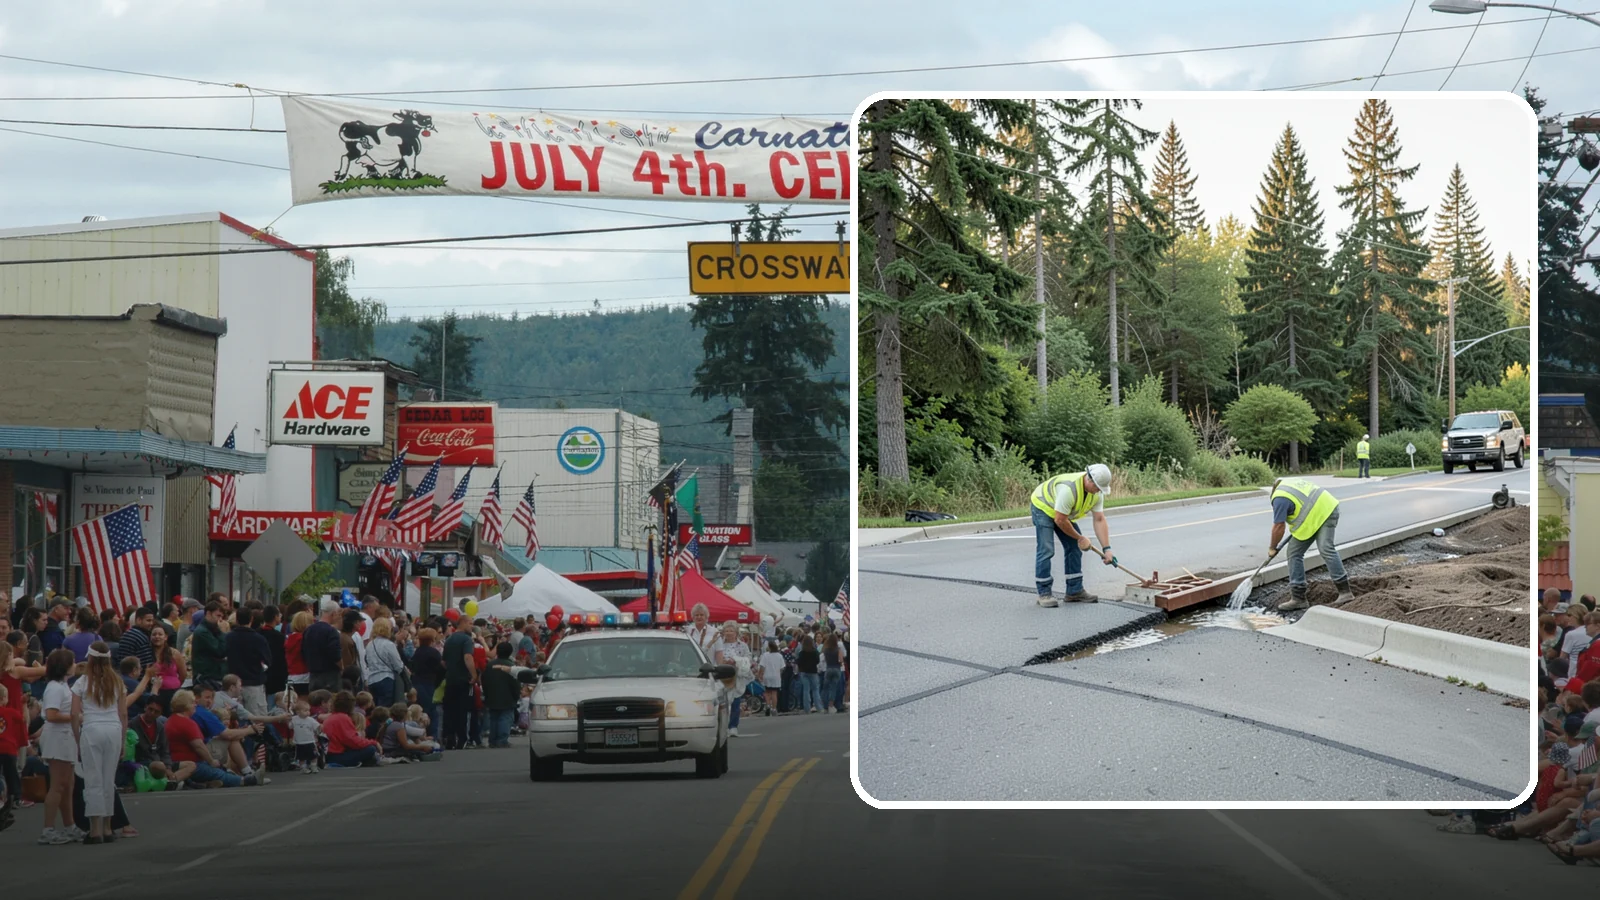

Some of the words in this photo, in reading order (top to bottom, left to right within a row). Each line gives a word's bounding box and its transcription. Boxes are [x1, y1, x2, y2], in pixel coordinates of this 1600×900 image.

[481, 141, 604, 191] JULY
[632, 150, 746, 198] 4th.
[697, 254, 850, 280] CROSSWA
[282, 380, 373, 420] ACE
[406, 409, 452, 422] CEDAR
[461, 409, 485, 422] LOG
[283, 421, 371, 437] Hardware
[416, 428, 477, 447] Coca-Cola
[353, 467, 386, 481] Simpl
[83, 485, 94, 494] St.
[96, 485, 124, 495] Vincent
[126, 486, 135, 495] de
[138, 486, 155, 496] Paul
[688, 527, 741, 535] CRNATION
[699, 535, 730, 543] GLASS
